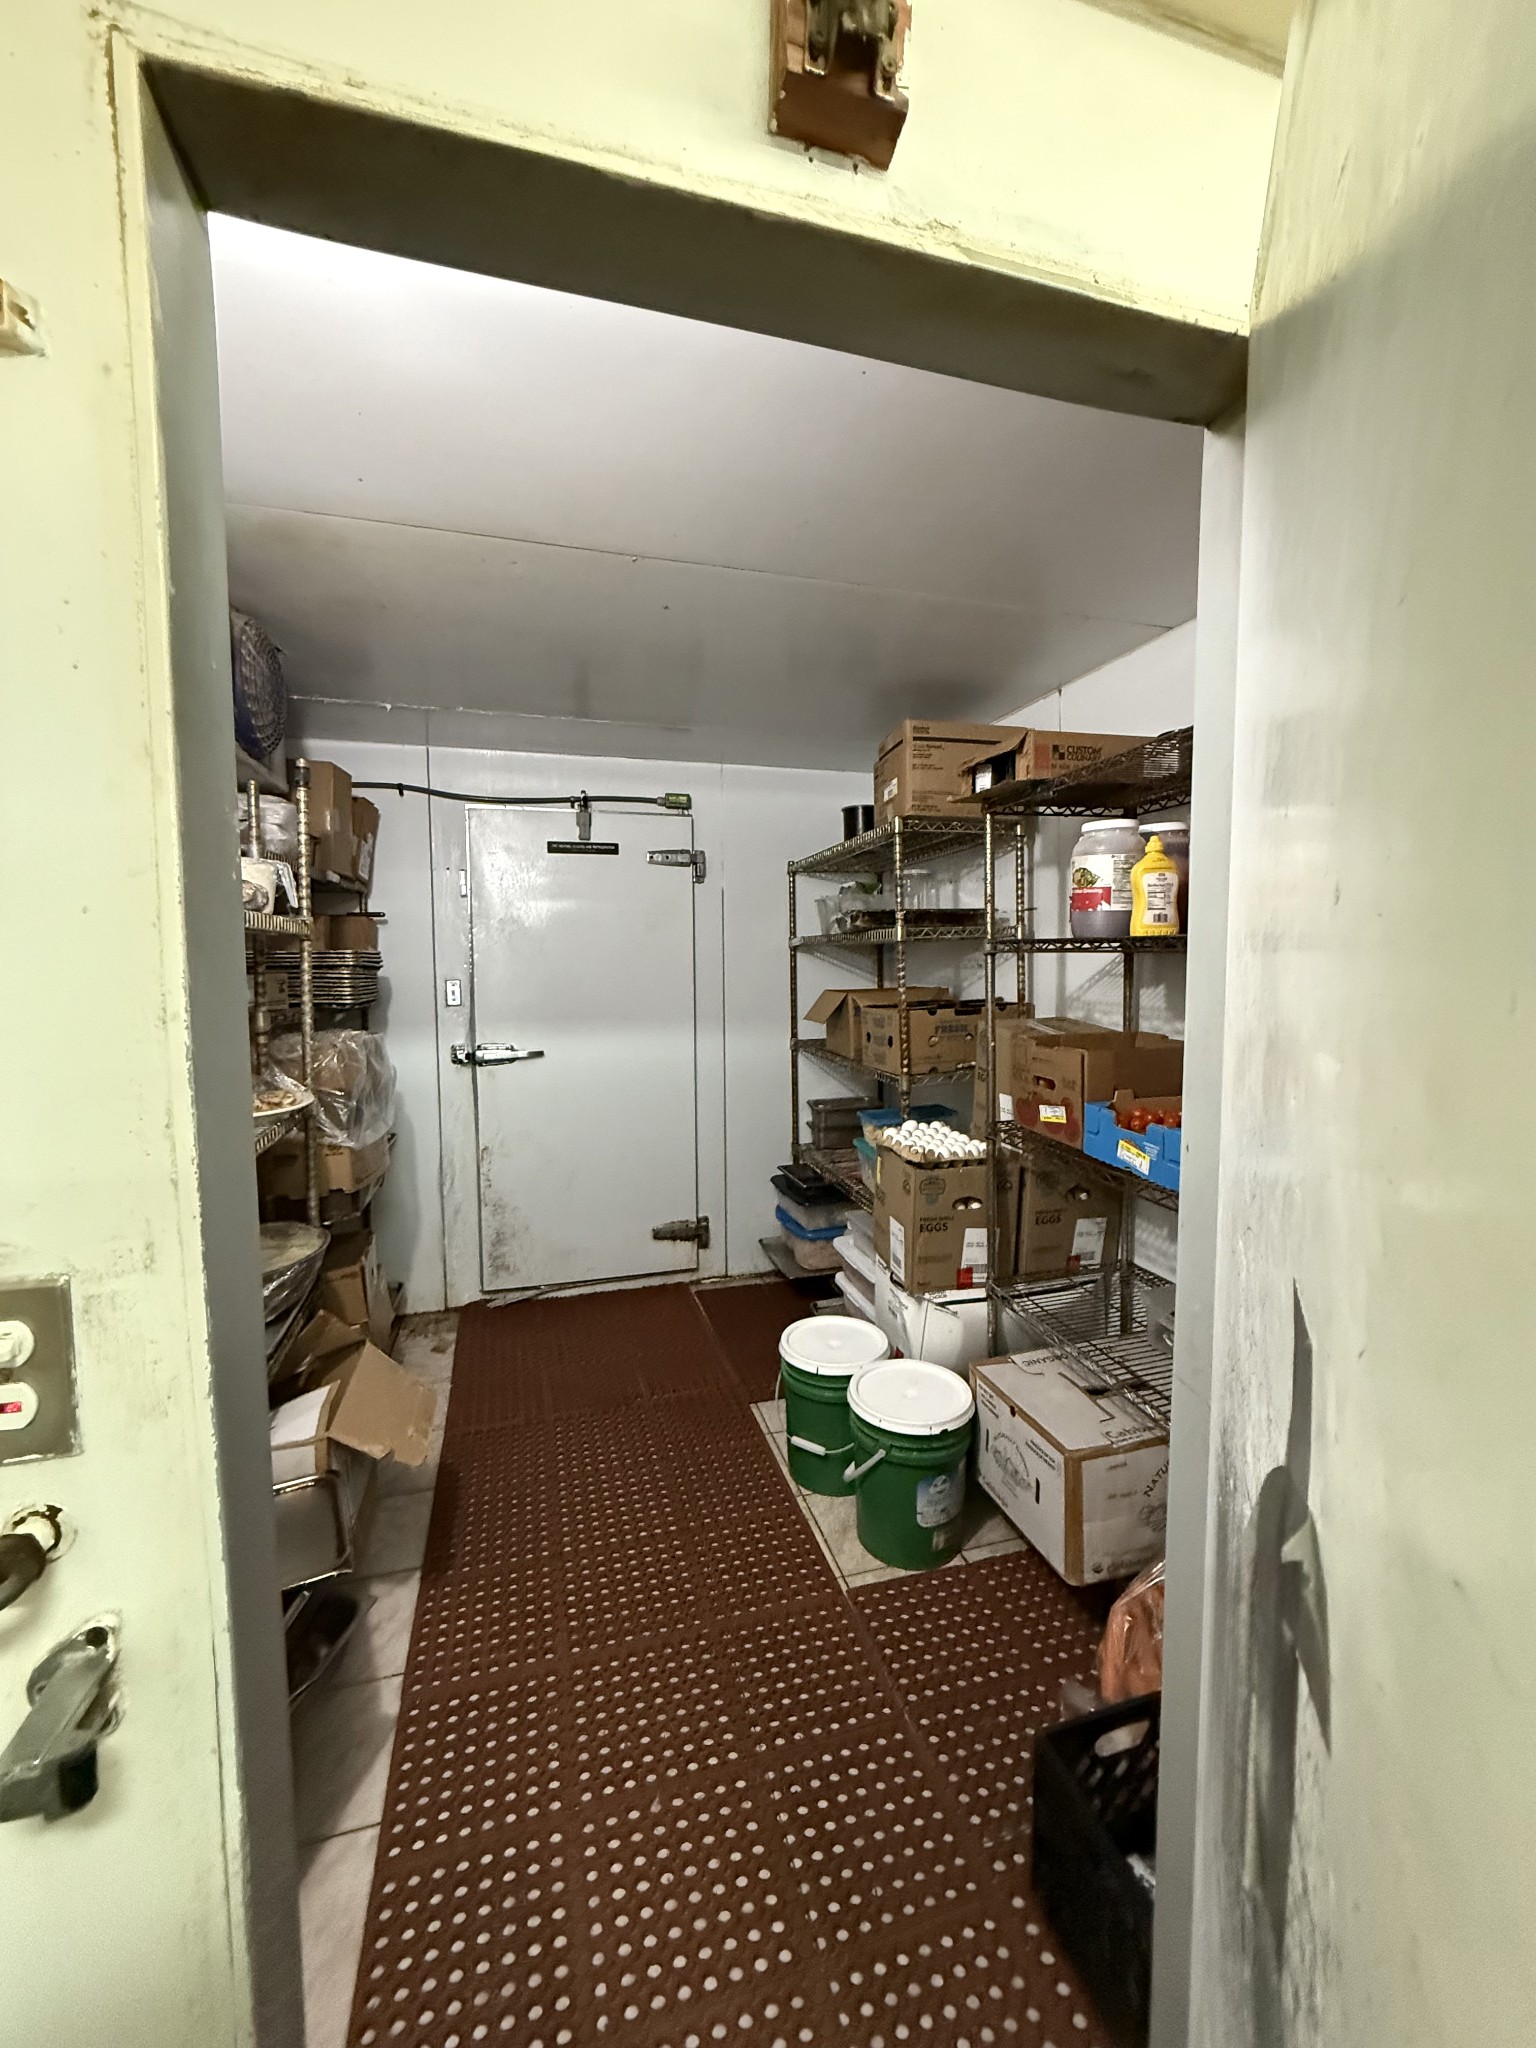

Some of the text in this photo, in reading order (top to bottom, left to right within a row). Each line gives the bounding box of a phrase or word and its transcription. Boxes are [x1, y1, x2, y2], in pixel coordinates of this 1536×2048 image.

[1066, 745, 1102, 754] CUSTOM
[1034, 1214, 1062, 1226] EGGS
[919, 1222, 948, 1233] EGGS
[1022, 1353, 1068, 1367] ORGANIC
